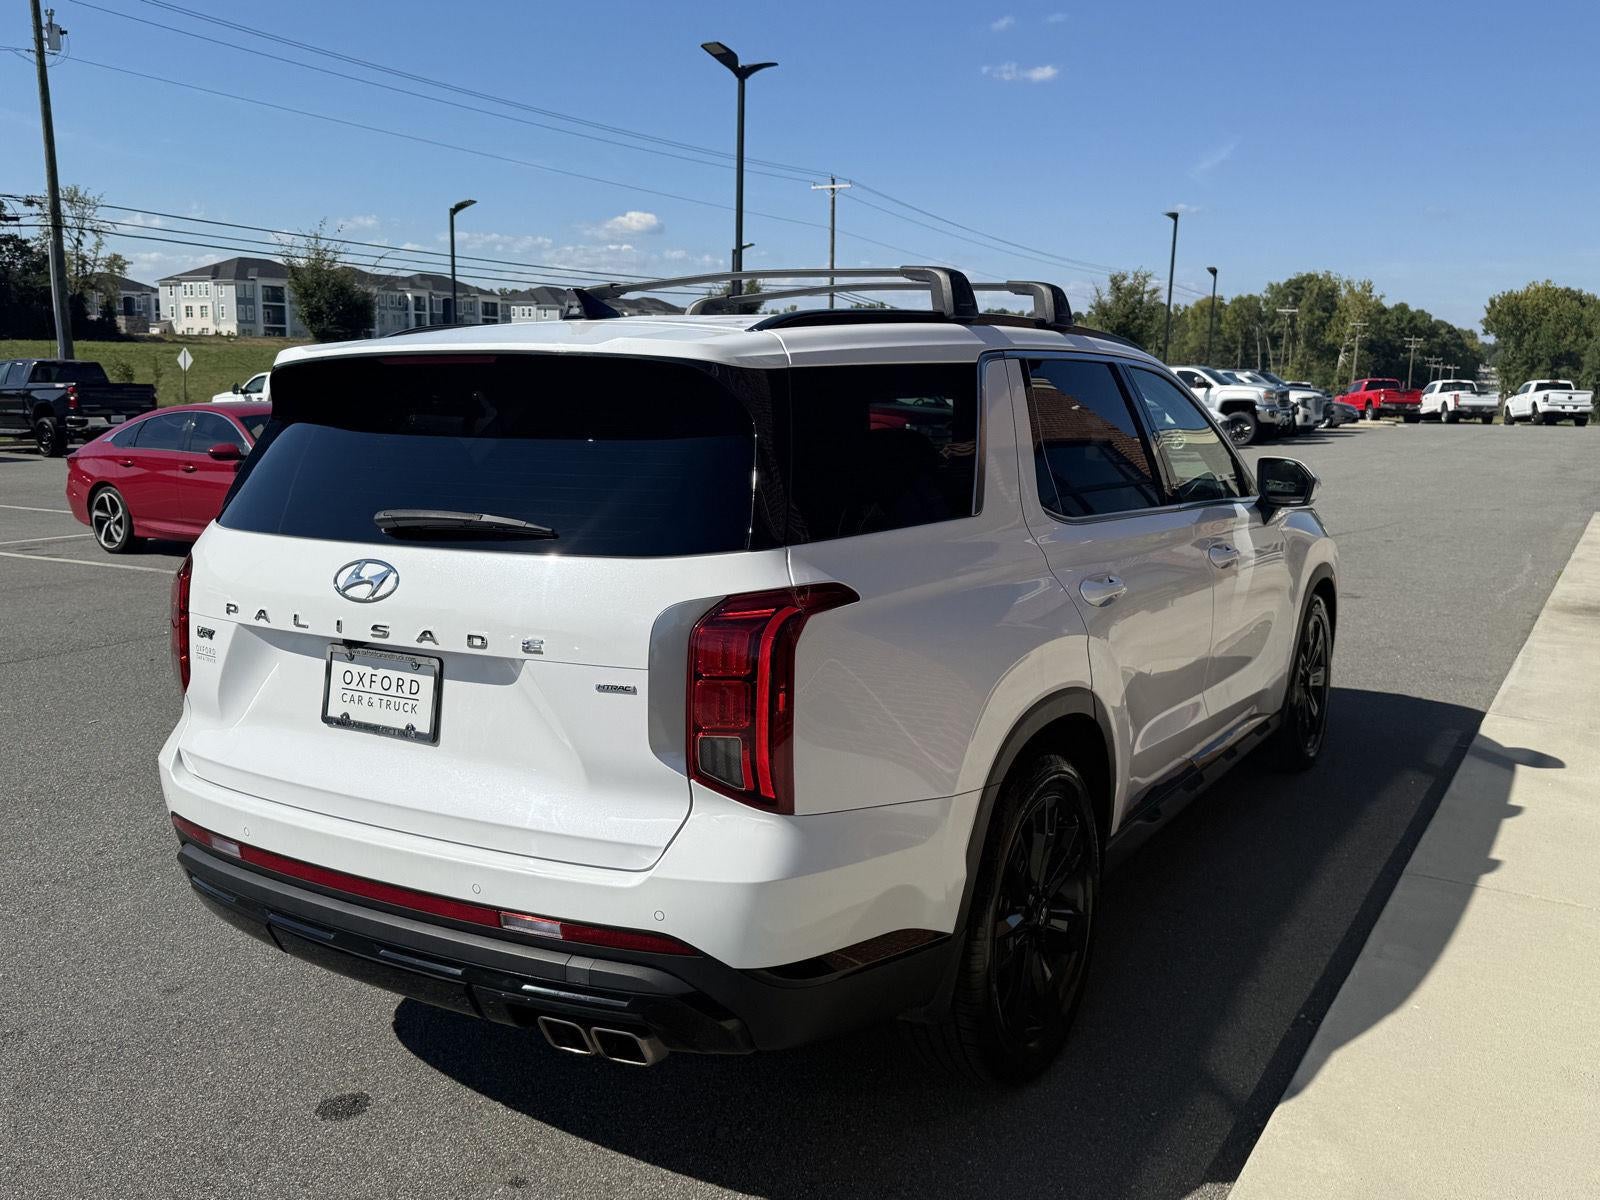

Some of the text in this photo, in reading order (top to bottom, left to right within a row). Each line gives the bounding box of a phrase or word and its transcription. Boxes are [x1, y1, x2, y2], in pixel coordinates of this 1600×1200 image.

[226, 603, 544, 654] PALISADE
[342, 669, 420, 695] OXFORD
[596, 684, 633, 693] HTRAC
[341, 692, 418, 715] CAR & TRUCK
